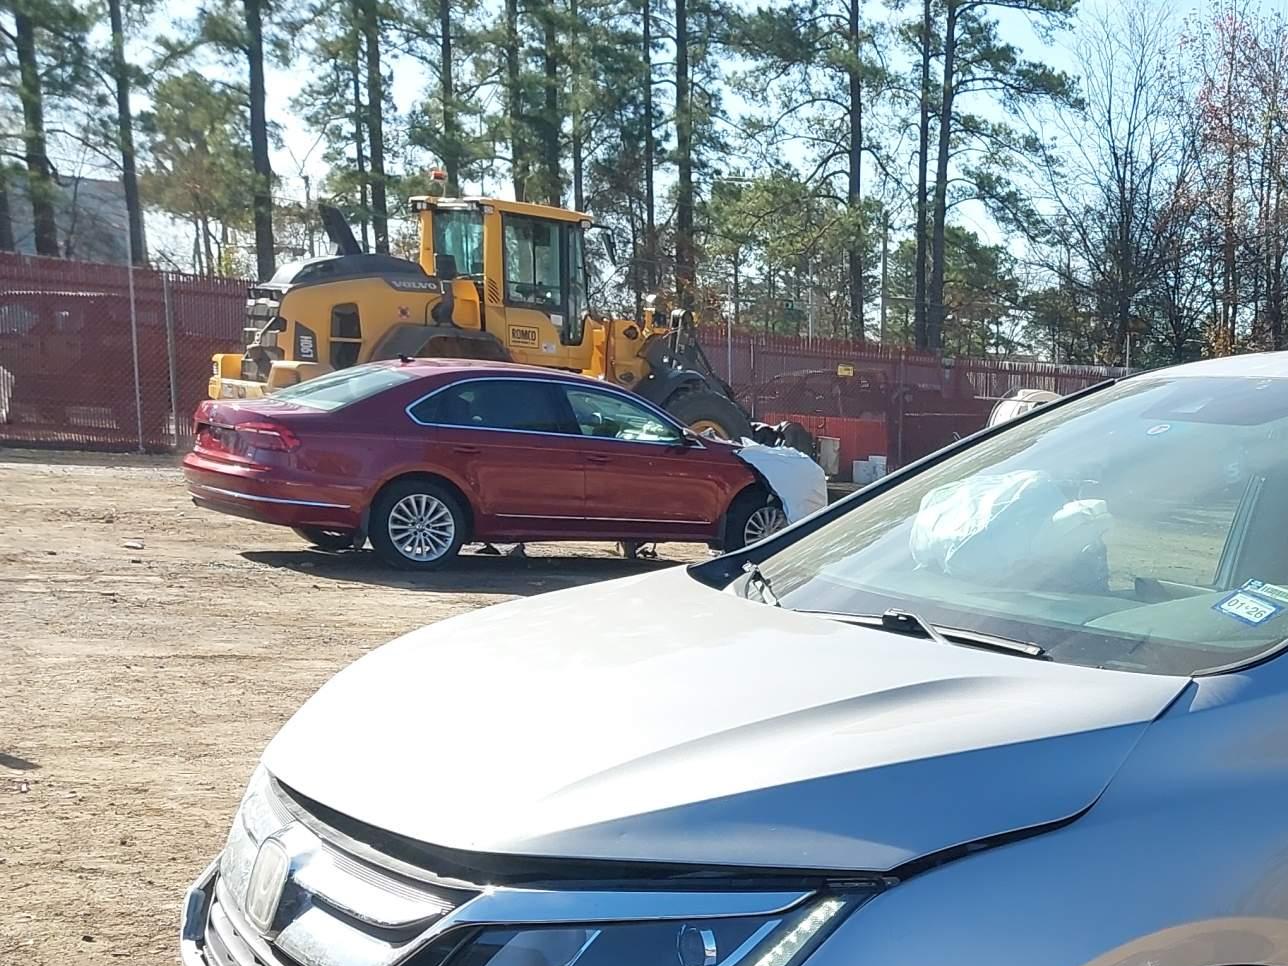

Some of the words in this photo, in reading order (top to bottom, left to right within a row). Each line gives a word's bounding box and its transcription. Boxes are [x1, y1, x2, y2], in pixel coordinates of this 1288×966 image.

[391, 280, 437, 290] VOLVO
[511, 327, 537, 341] ROMCO
[299, 335, 314, 358] L90H
